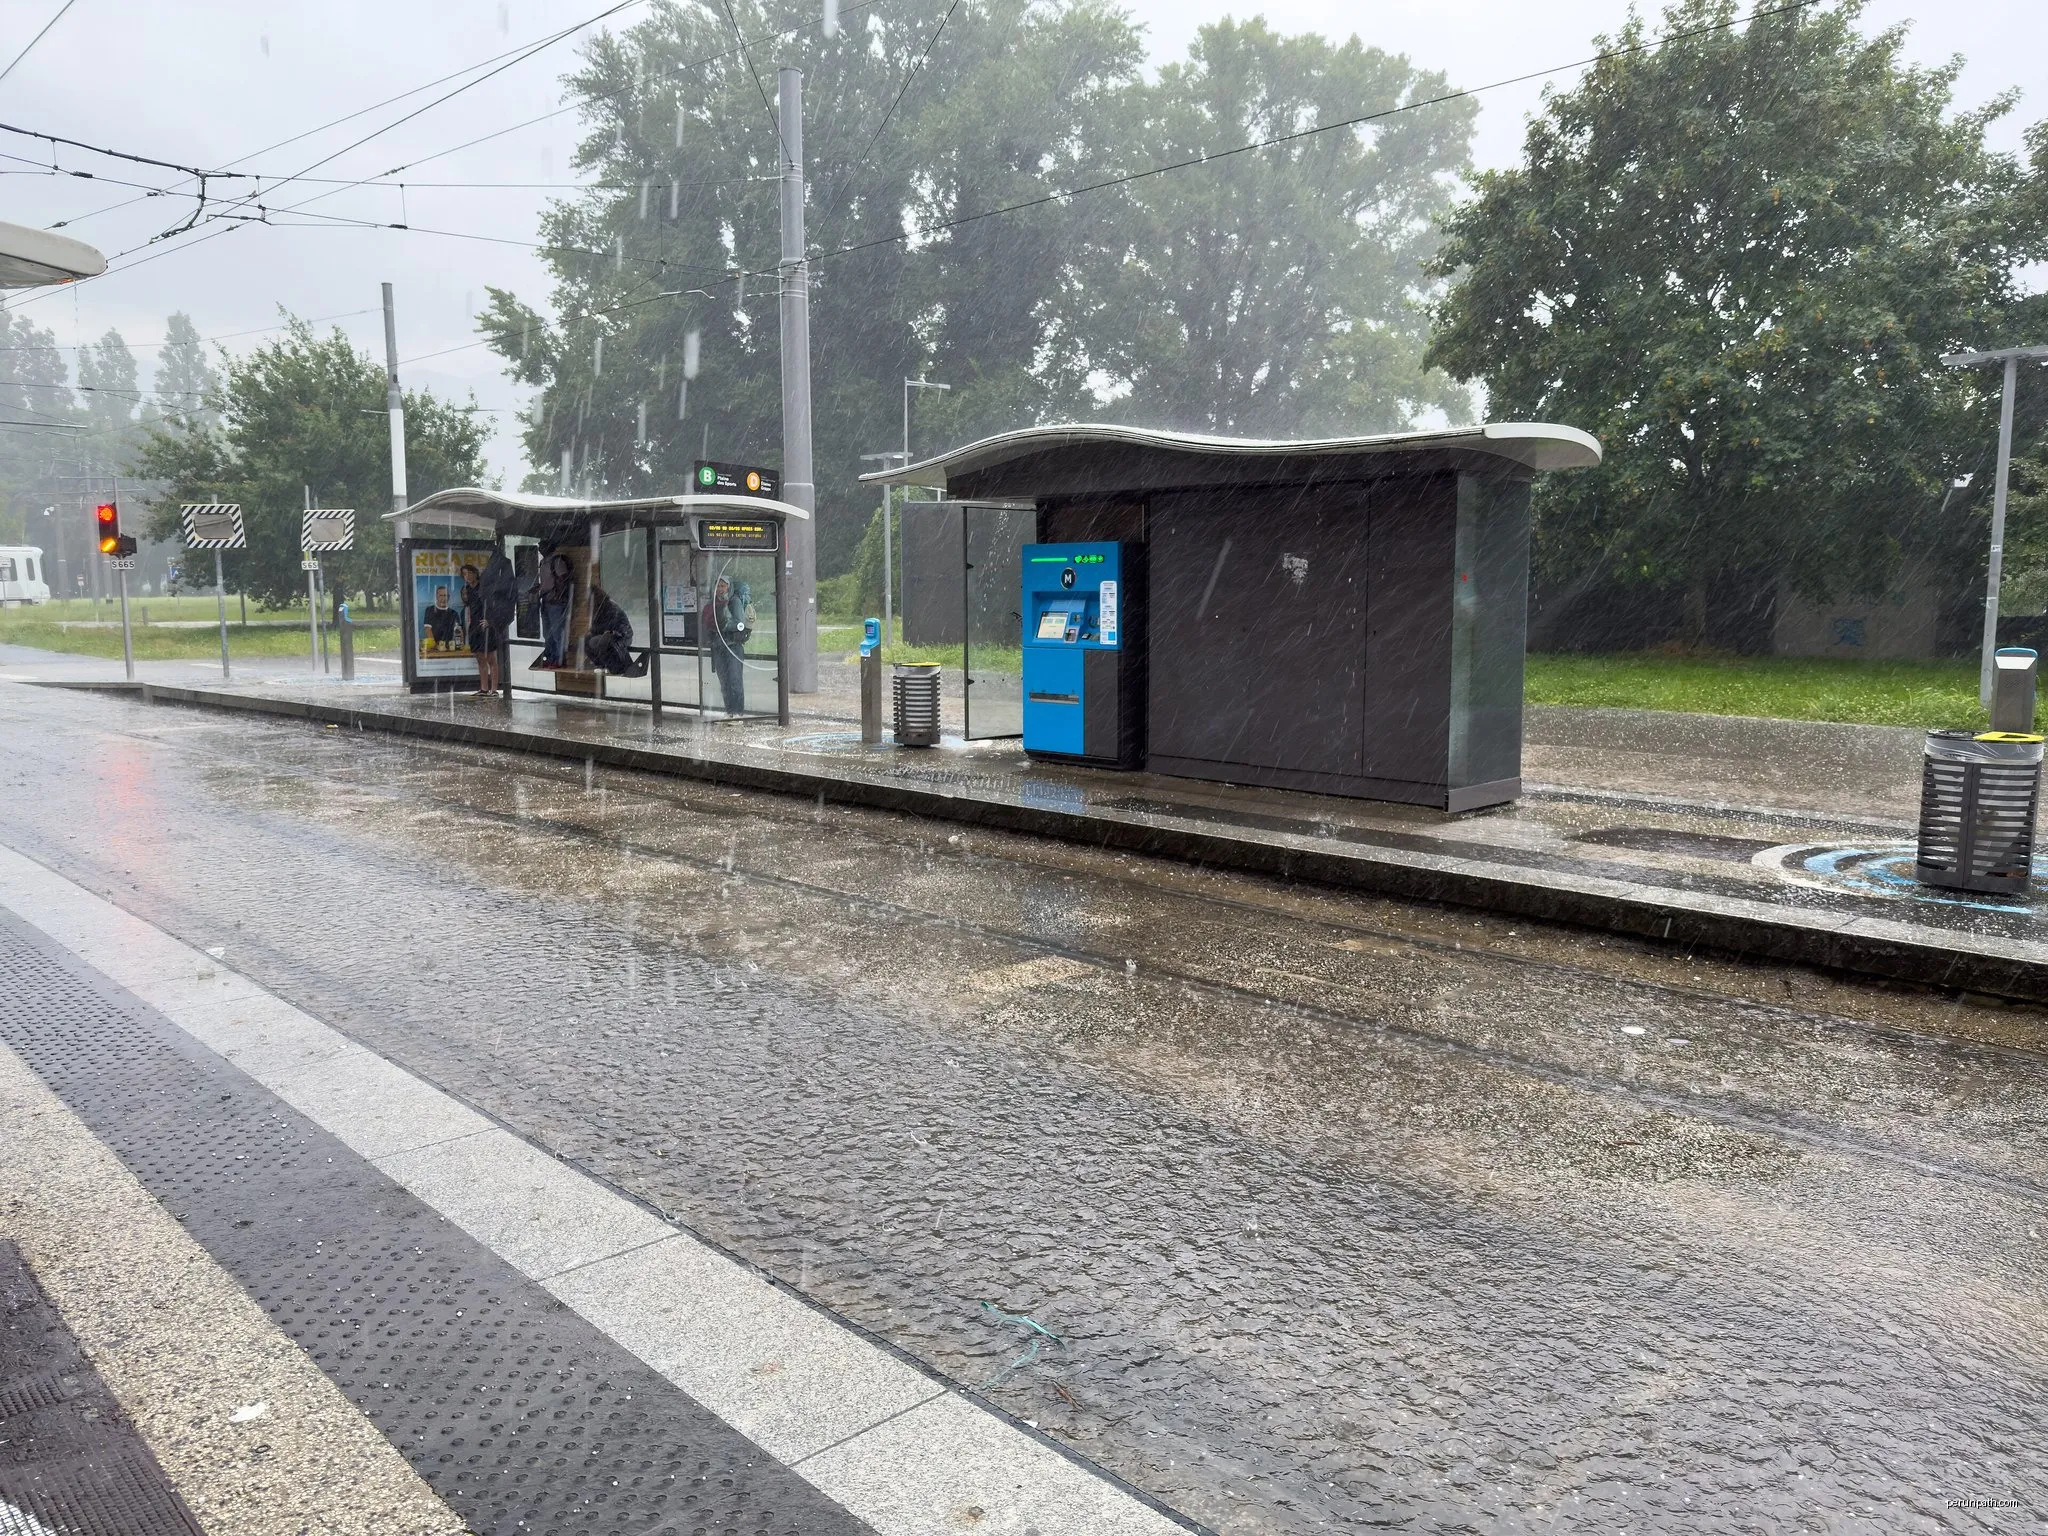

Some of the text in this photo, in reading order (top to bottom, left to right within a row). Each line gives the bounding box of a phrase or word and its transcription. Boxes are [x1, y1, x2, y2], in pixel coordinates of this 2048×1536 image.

[703, 469, 712, 482] B
[750, 476, 757, 487] D
[416, 552, 489, 567] RICARD
[1064, 573, 1072, 583] M
